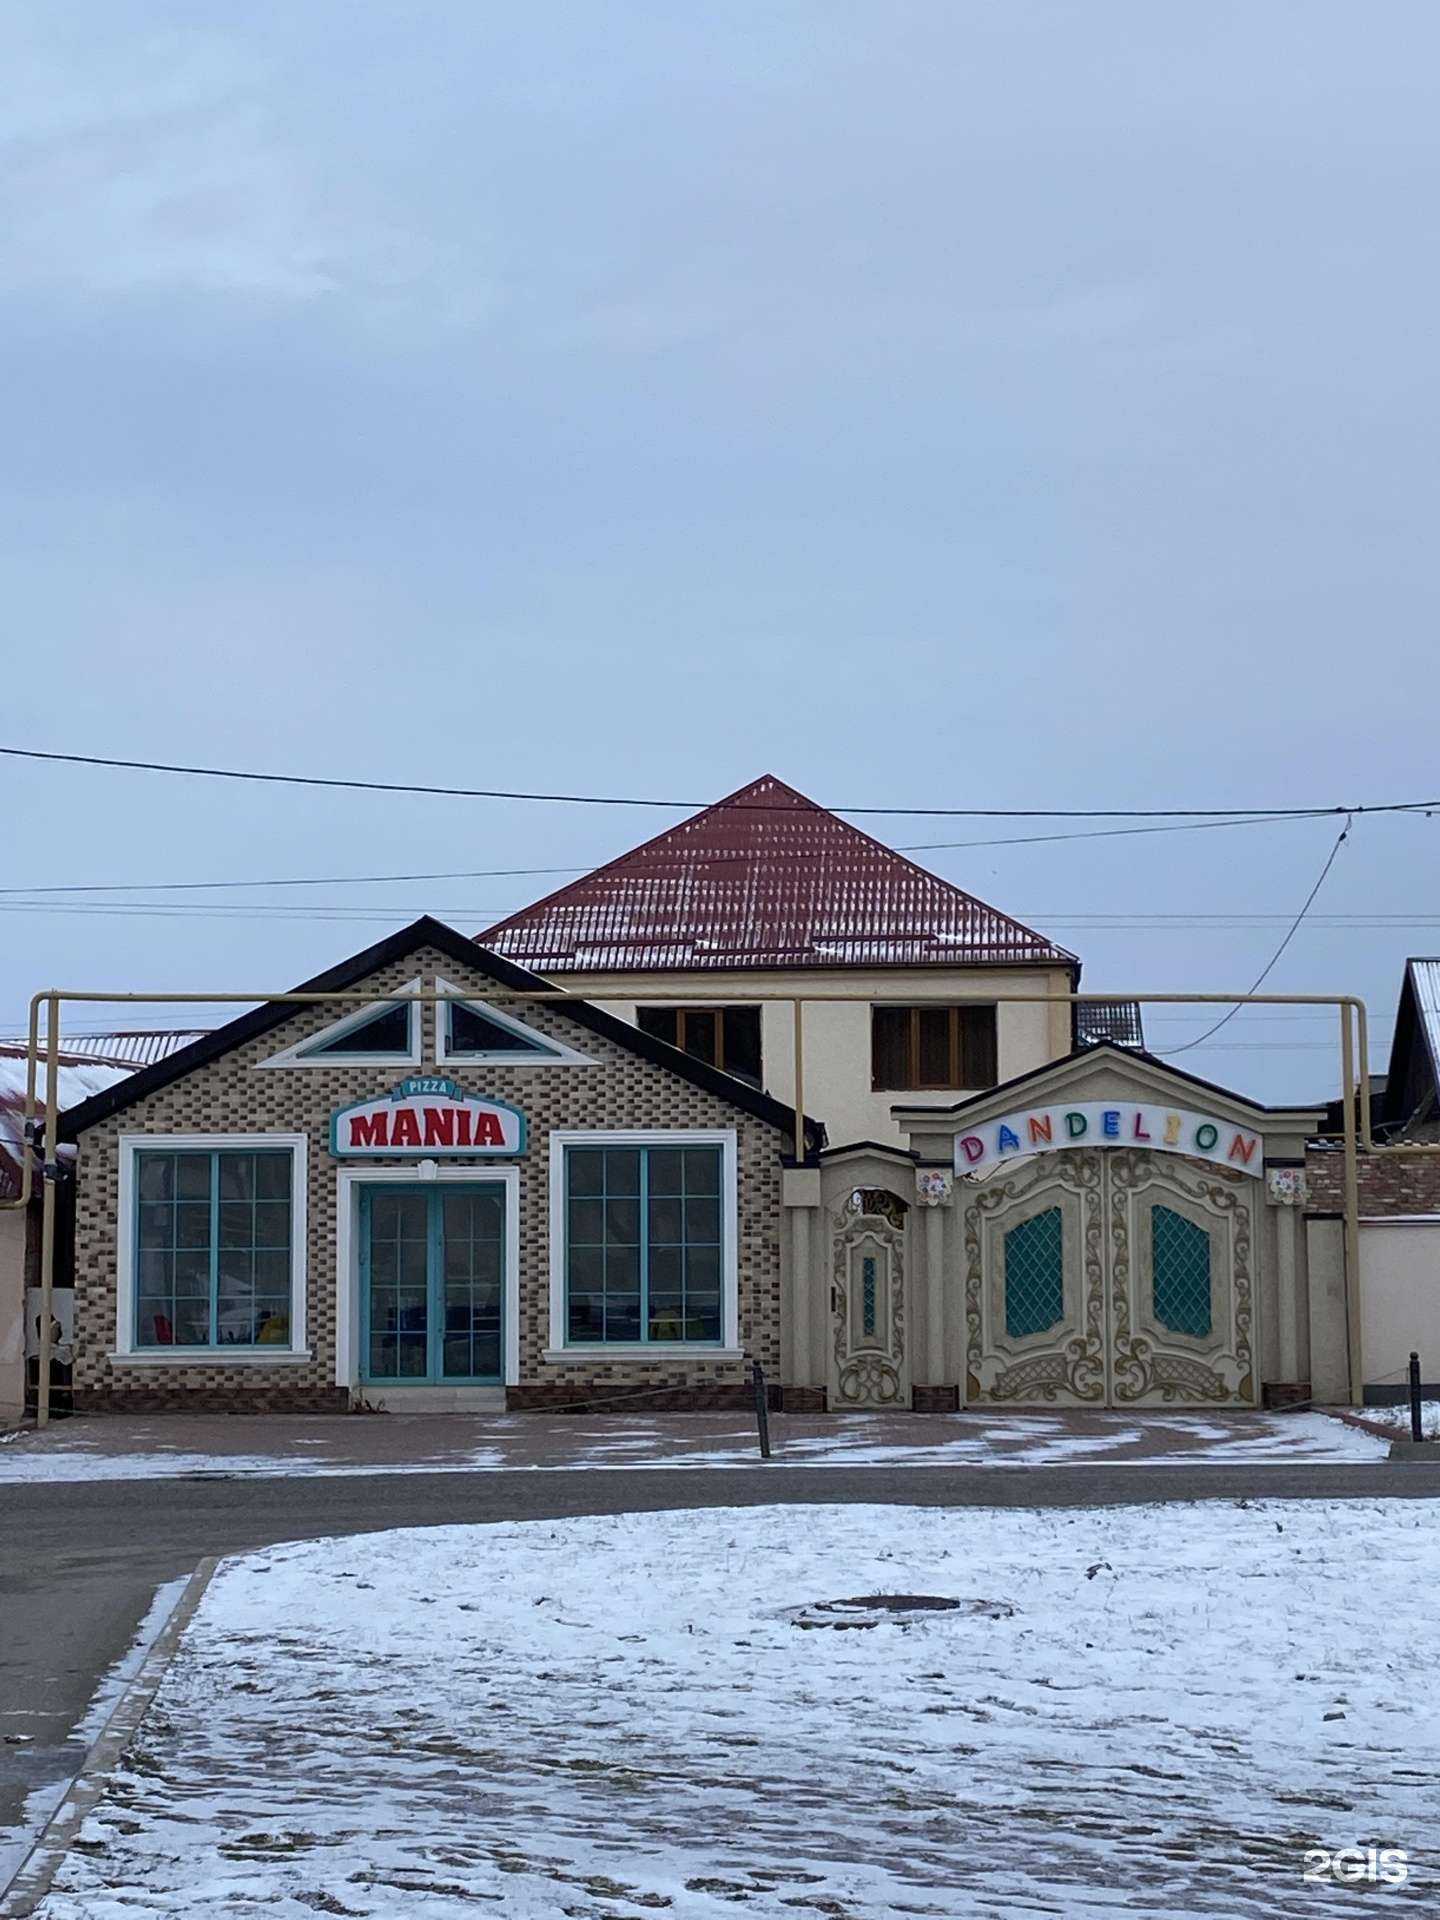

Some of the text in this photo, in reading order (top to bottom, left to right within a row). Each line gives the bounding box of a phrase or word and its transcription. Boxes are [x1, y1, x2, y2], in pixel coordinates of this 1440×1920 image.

[409, 1080, 447, 1093] PIZZA
[349, 1108, 505, 1147] MANIA
[960, 1110, 1256, 1164] DANDELION
